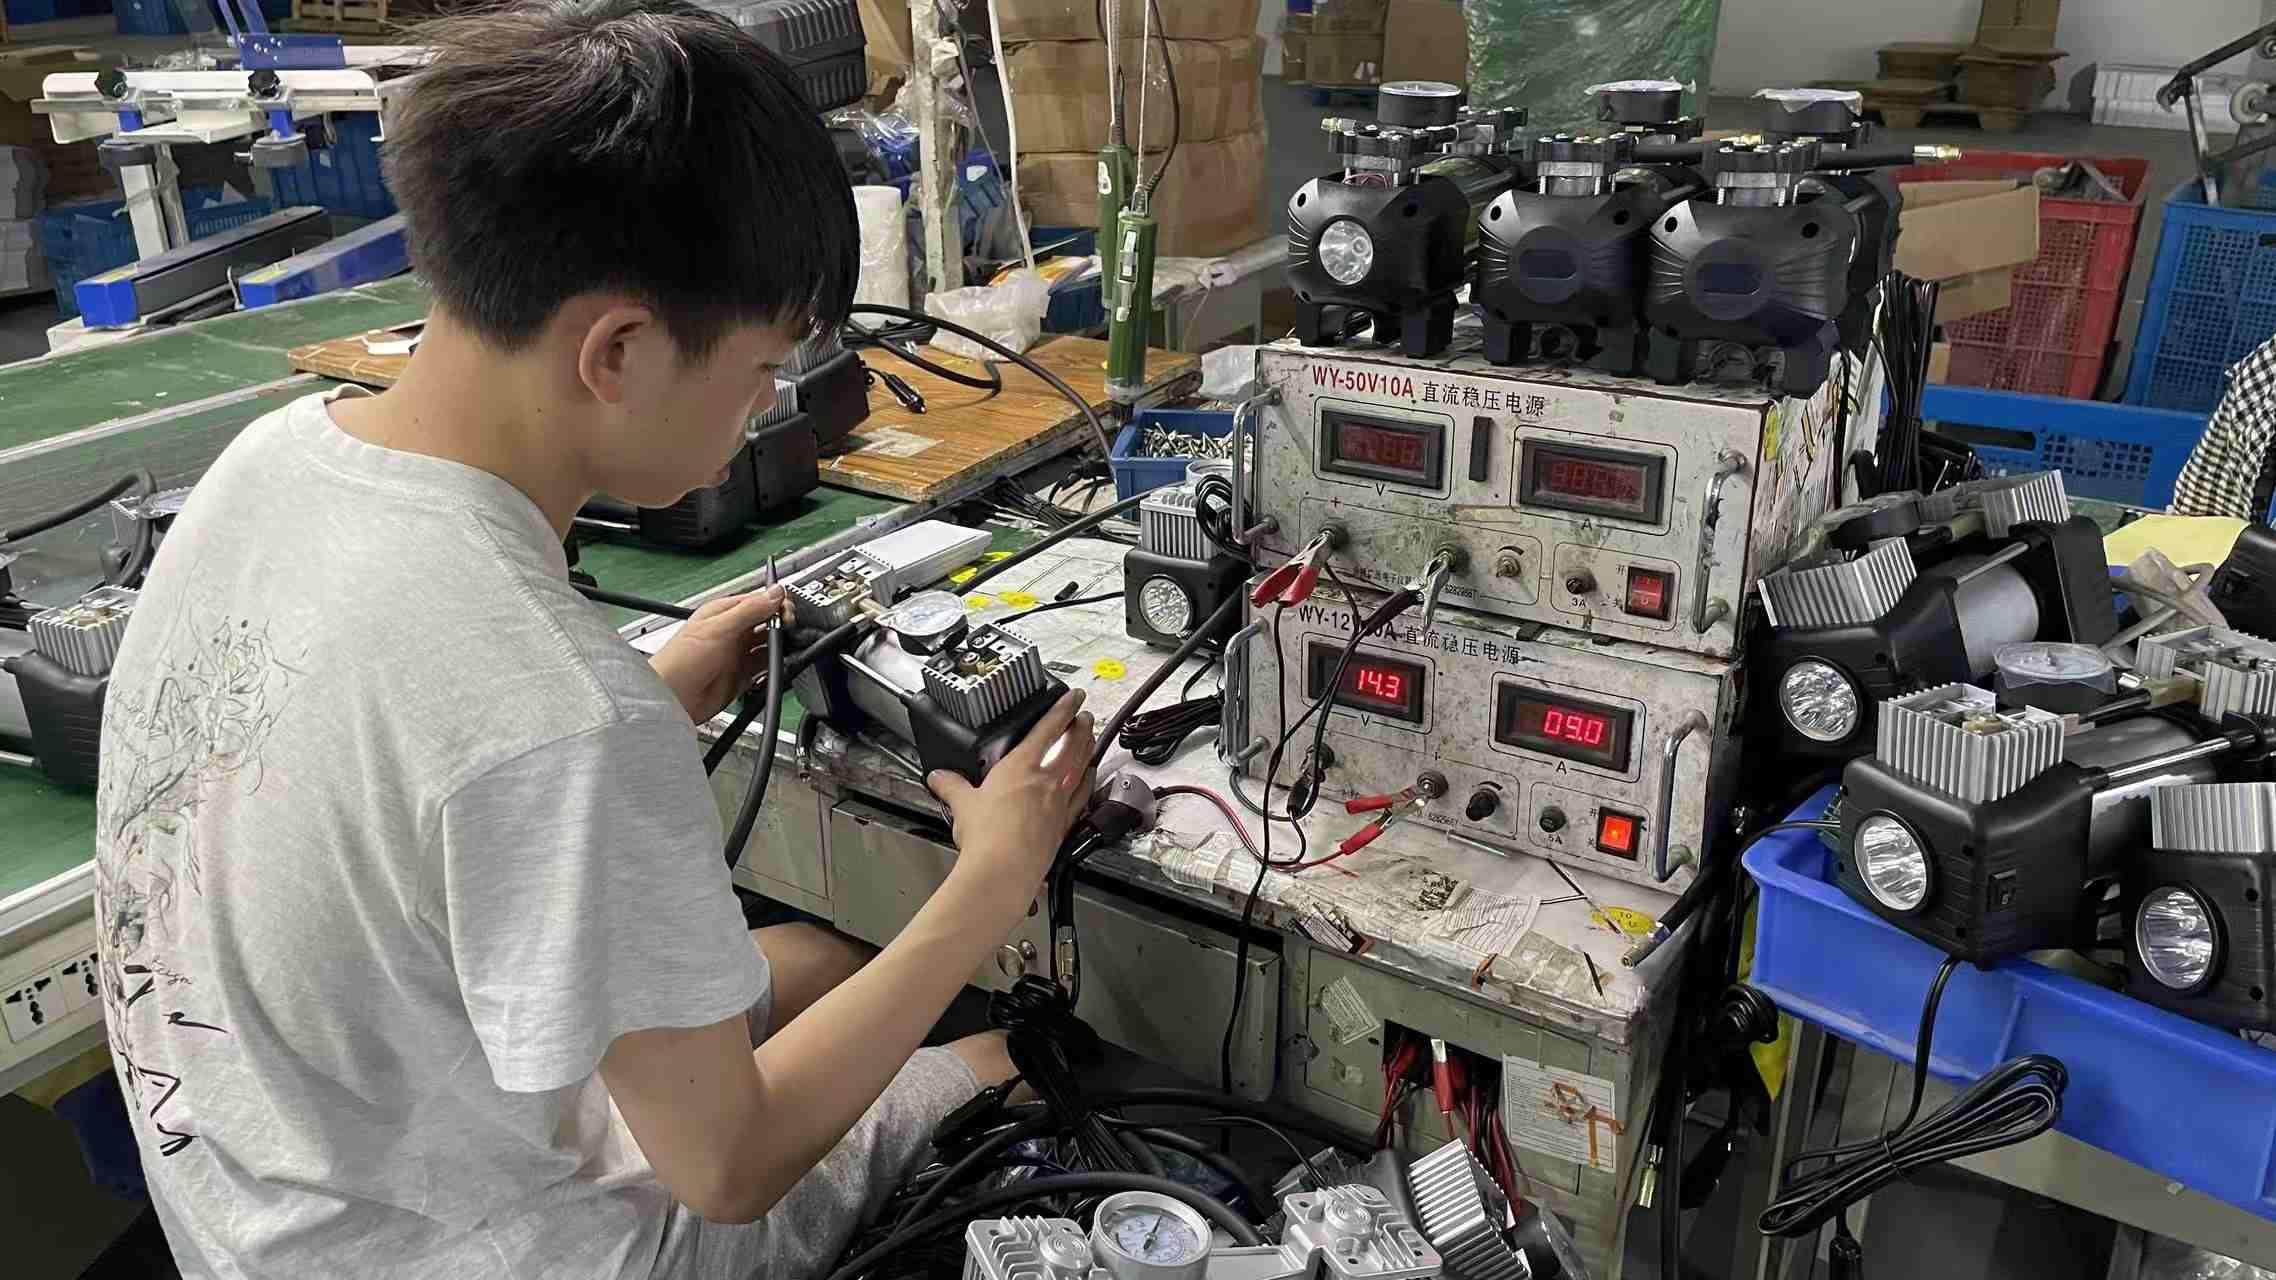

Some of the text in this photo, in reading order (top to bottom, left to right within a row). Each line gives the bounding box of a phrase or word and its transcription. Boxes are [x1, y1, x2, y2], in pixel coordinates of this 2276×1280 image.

[1312, 365, 1545, 417] WY-50V10A 直流稳压电源
[1375, 482, 1385, 497] V
[1581, 518, 1593, 531] A
[1404, 625, 1521, 665] 直流稳压电源
[1358, 669, 1401, 699] 14.3
[1361, 713, 1370, 726] V
[1543, 709, 1604, 745] 09.0
[1555, 760, 1568, 775] A
